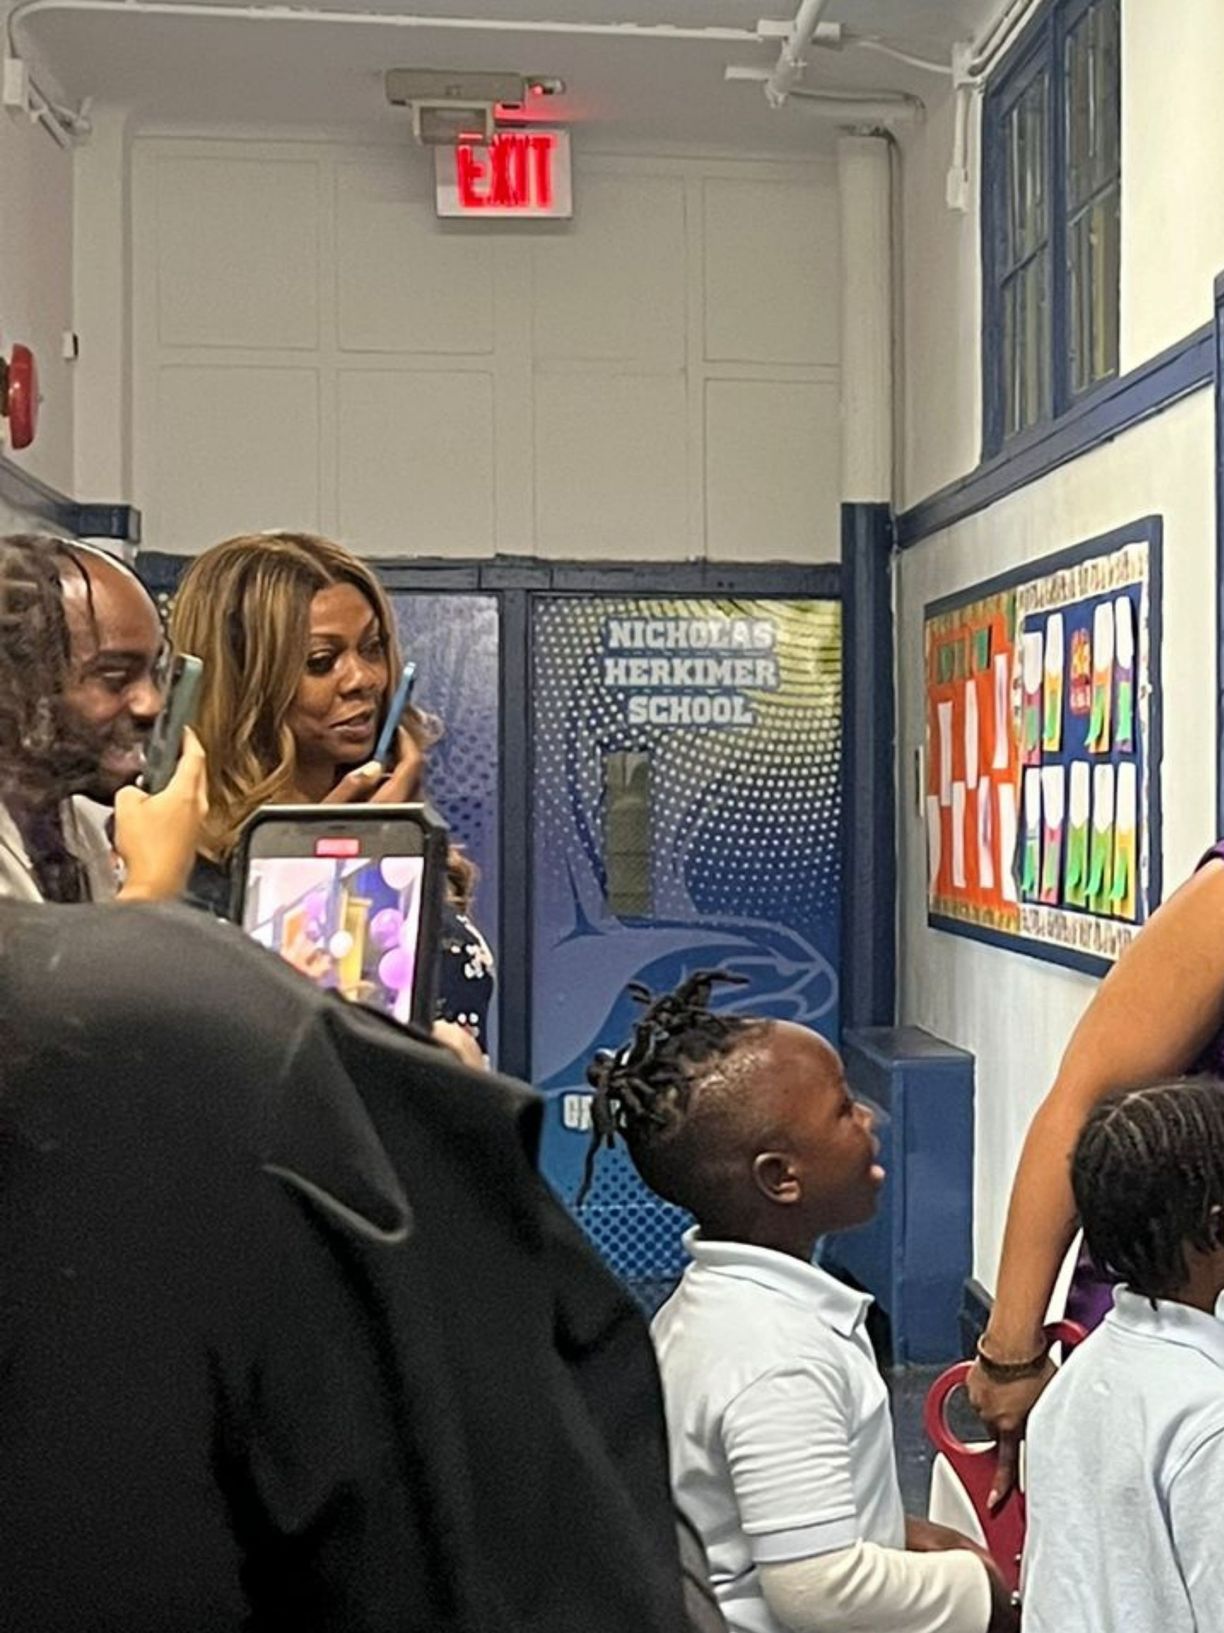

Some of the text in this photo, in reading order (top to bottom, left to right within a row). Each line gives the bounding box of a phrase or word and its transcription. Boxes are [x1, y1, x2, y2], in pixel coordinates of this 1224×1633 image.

[457, 133, 555, 208] EXIT
[607, 619, 775, 649] NICHOLAS
[603, 657, 778, 687] HERKIMER
[627, 695, 753, 724] SCHOOL
